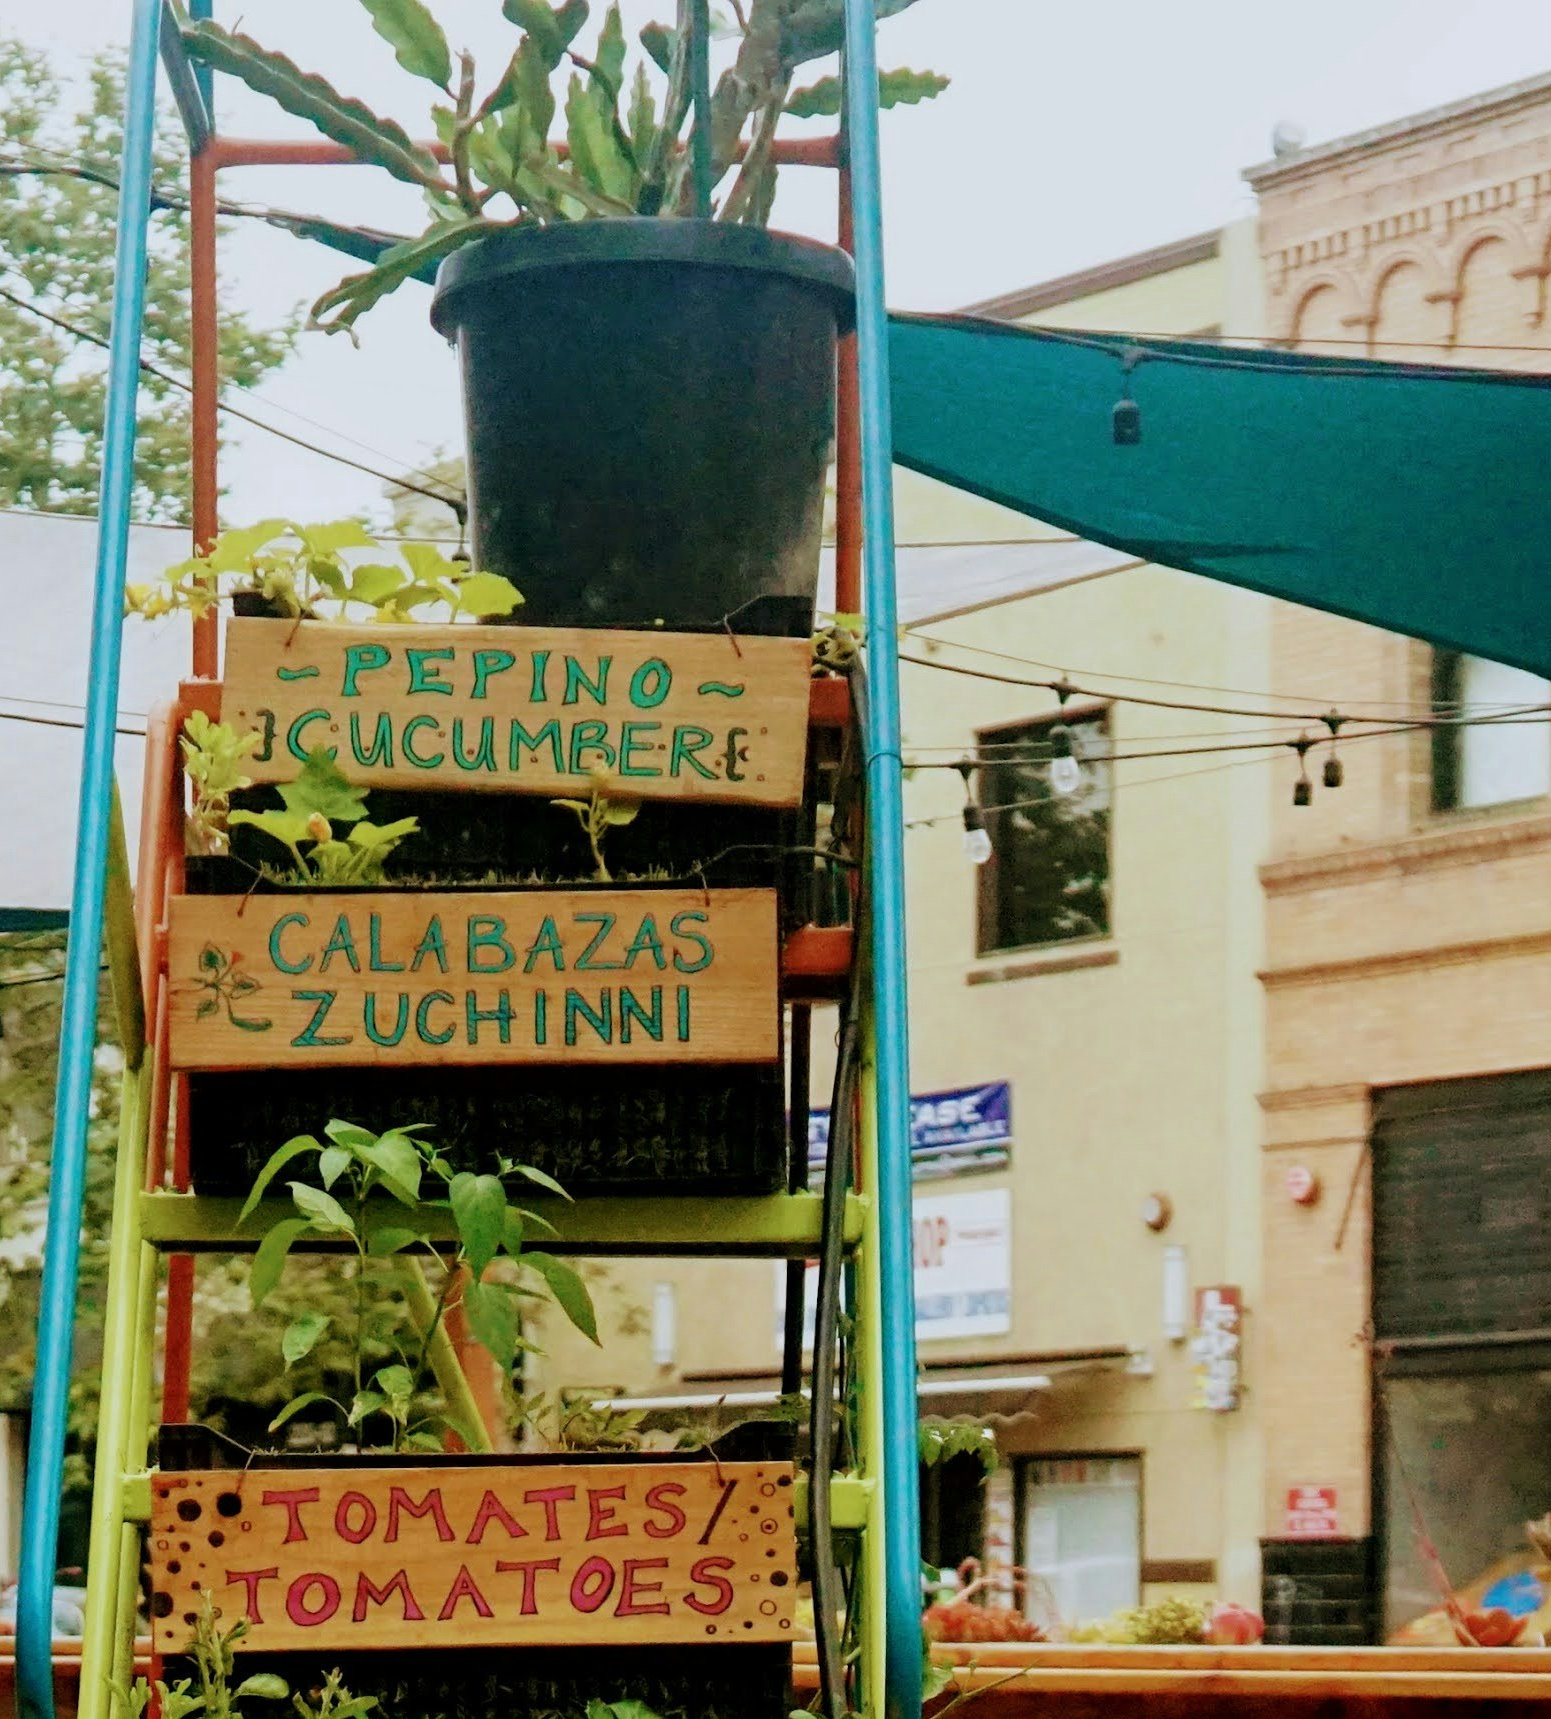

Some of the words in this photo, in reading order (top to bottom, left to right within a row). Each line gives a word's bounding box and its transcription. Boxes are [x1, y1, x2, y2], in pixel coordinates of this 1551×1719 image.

[340, 642, 674, 708] PEPINO
[267, 909, 715, 977] CALABAZAS
[289, 983, 693, 1049] ZUCHINNI
[224, 1554, 737, 1628] TOMATOES
